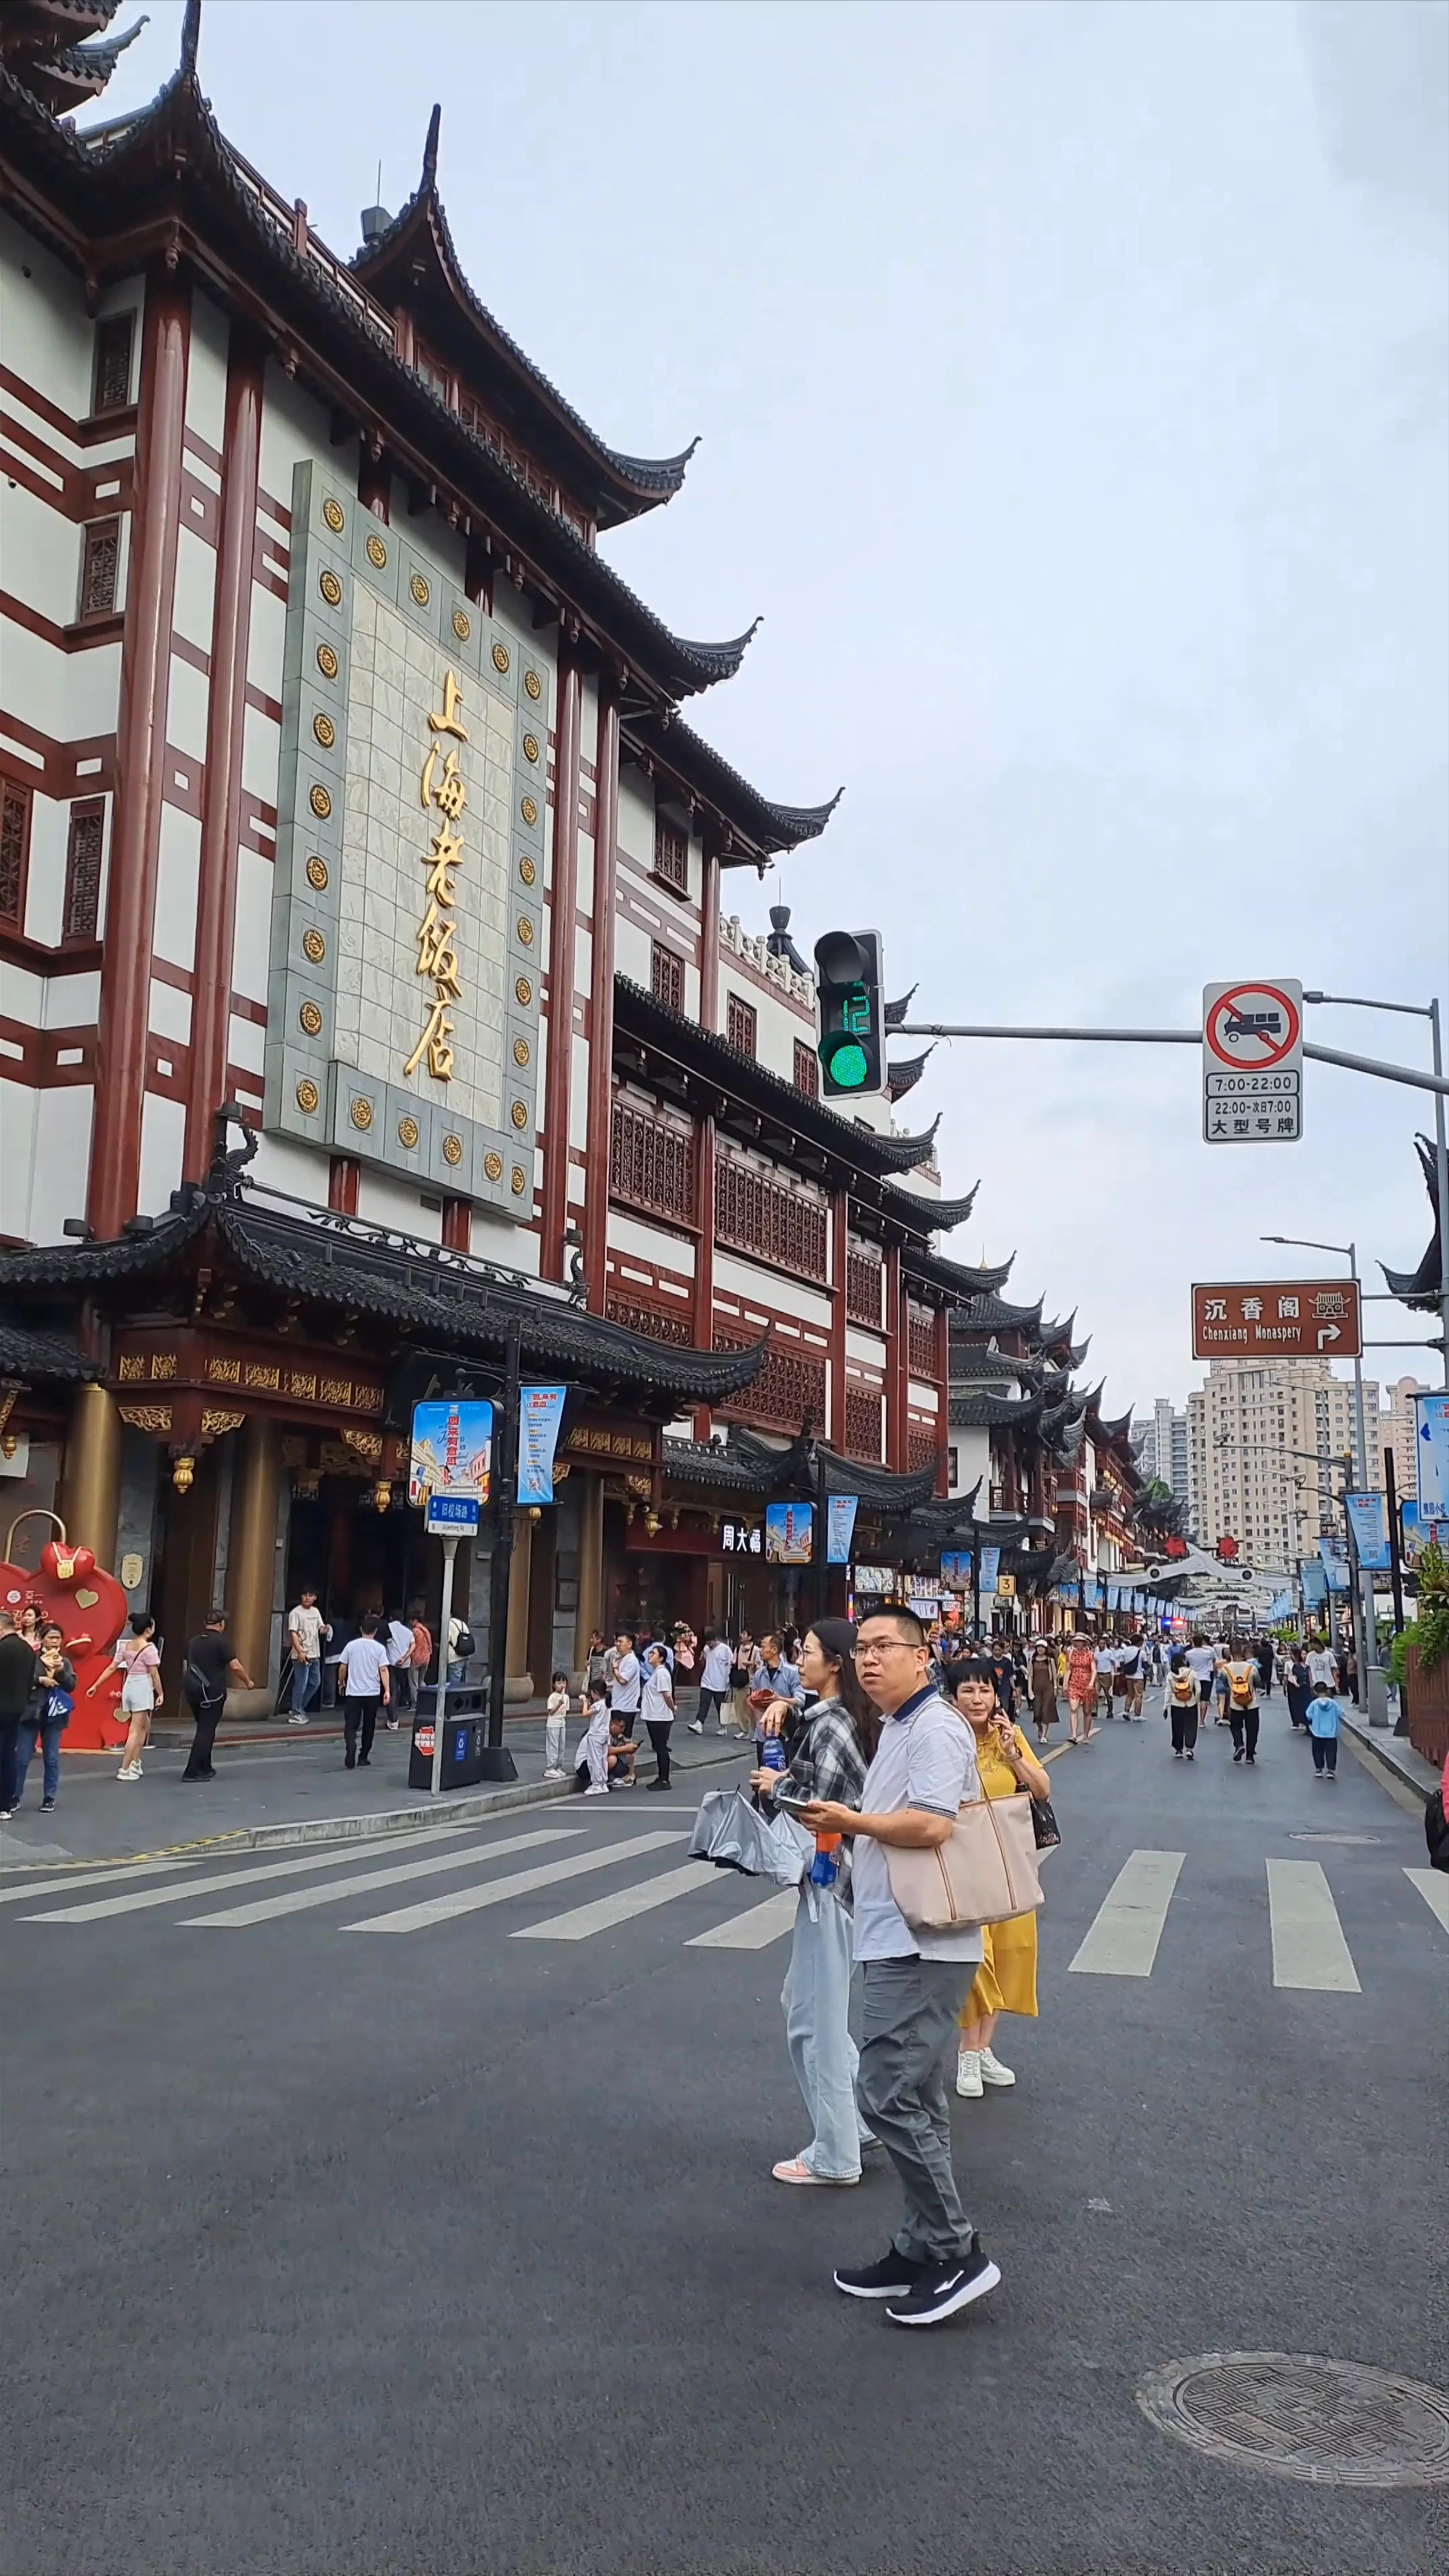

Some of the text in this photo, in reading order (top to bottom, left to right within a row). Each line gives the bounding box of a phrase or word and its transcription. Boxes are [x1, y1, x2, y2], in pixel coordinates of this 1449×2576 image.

[843, 995, 871, 1033] 12
[1215, 1077, 1291, 1092] 7:00-22:00
[1215, 1100, 1291, 1114] 22:00-次日7:00
[1211, 1117, 1294, 1134] 大型号牌
[1204, 1296, 1300, 1321] 沉香阁
[1203, 1324, 1247, 1344] Chenxiang
[723, 1525, 761, 1553] 周大福
[1003, 1578, 1010, 1590] 3
